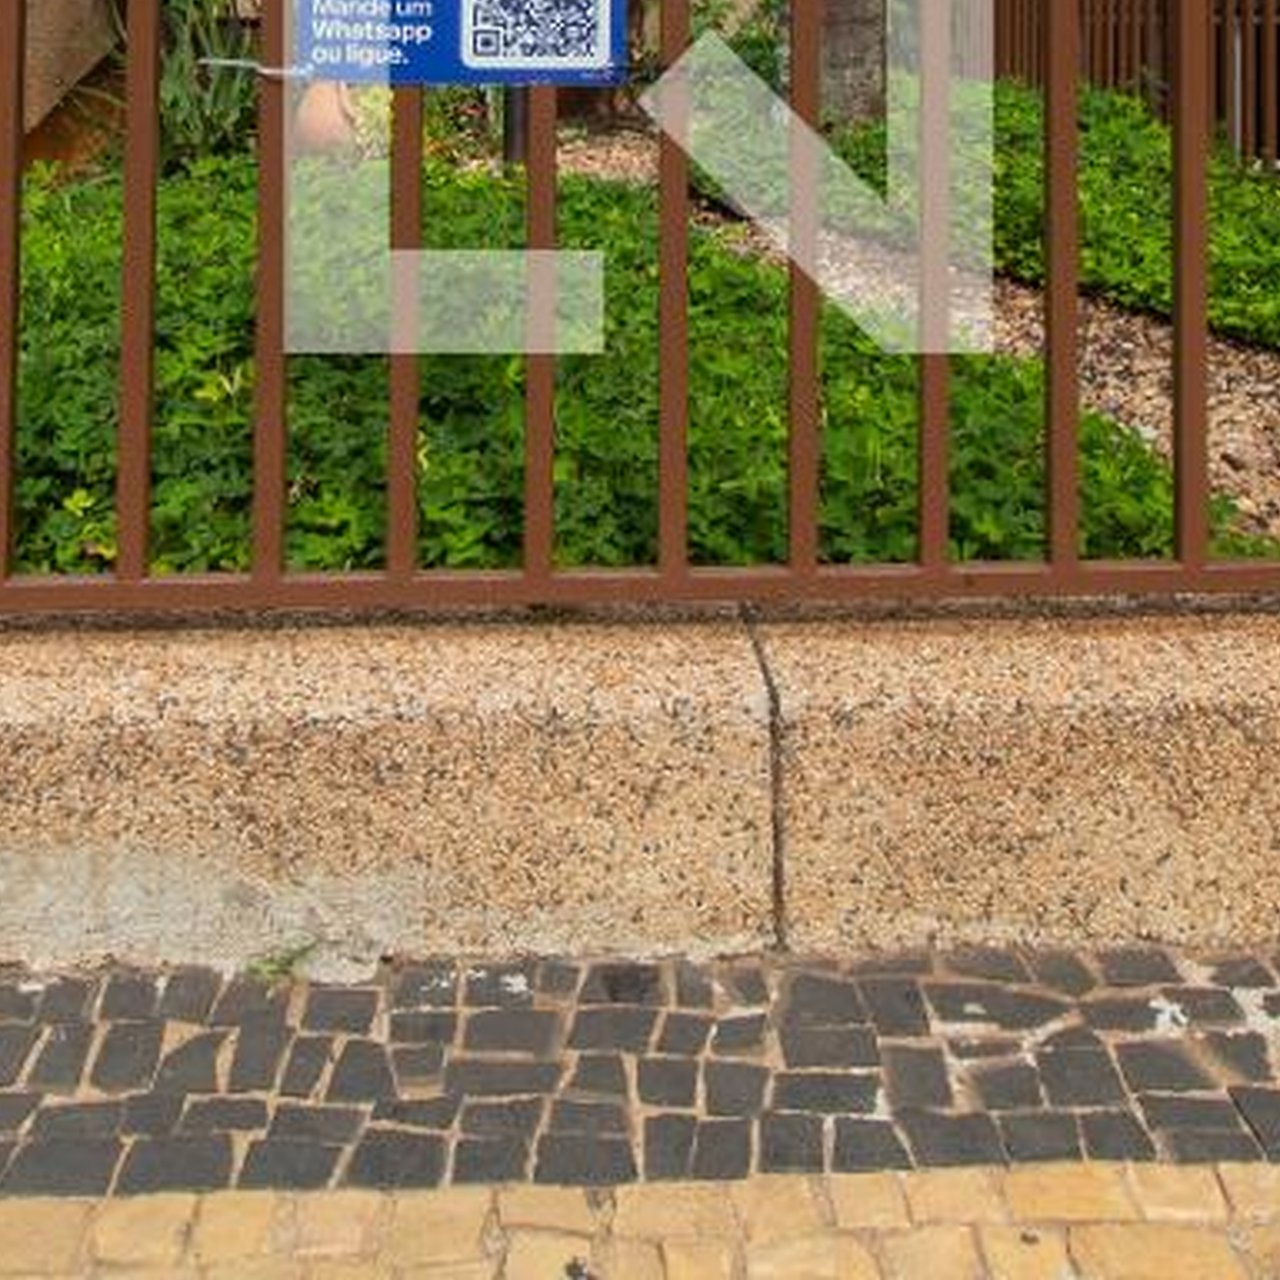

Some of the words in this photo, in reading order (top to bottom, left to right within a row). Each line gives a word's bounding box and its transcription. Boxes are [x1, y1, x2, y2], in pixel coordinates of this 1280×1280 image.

[395, 1, 433, 17] um
[312, 45, 341, 64] ou
[345, 41, 410, 68] ligue.
